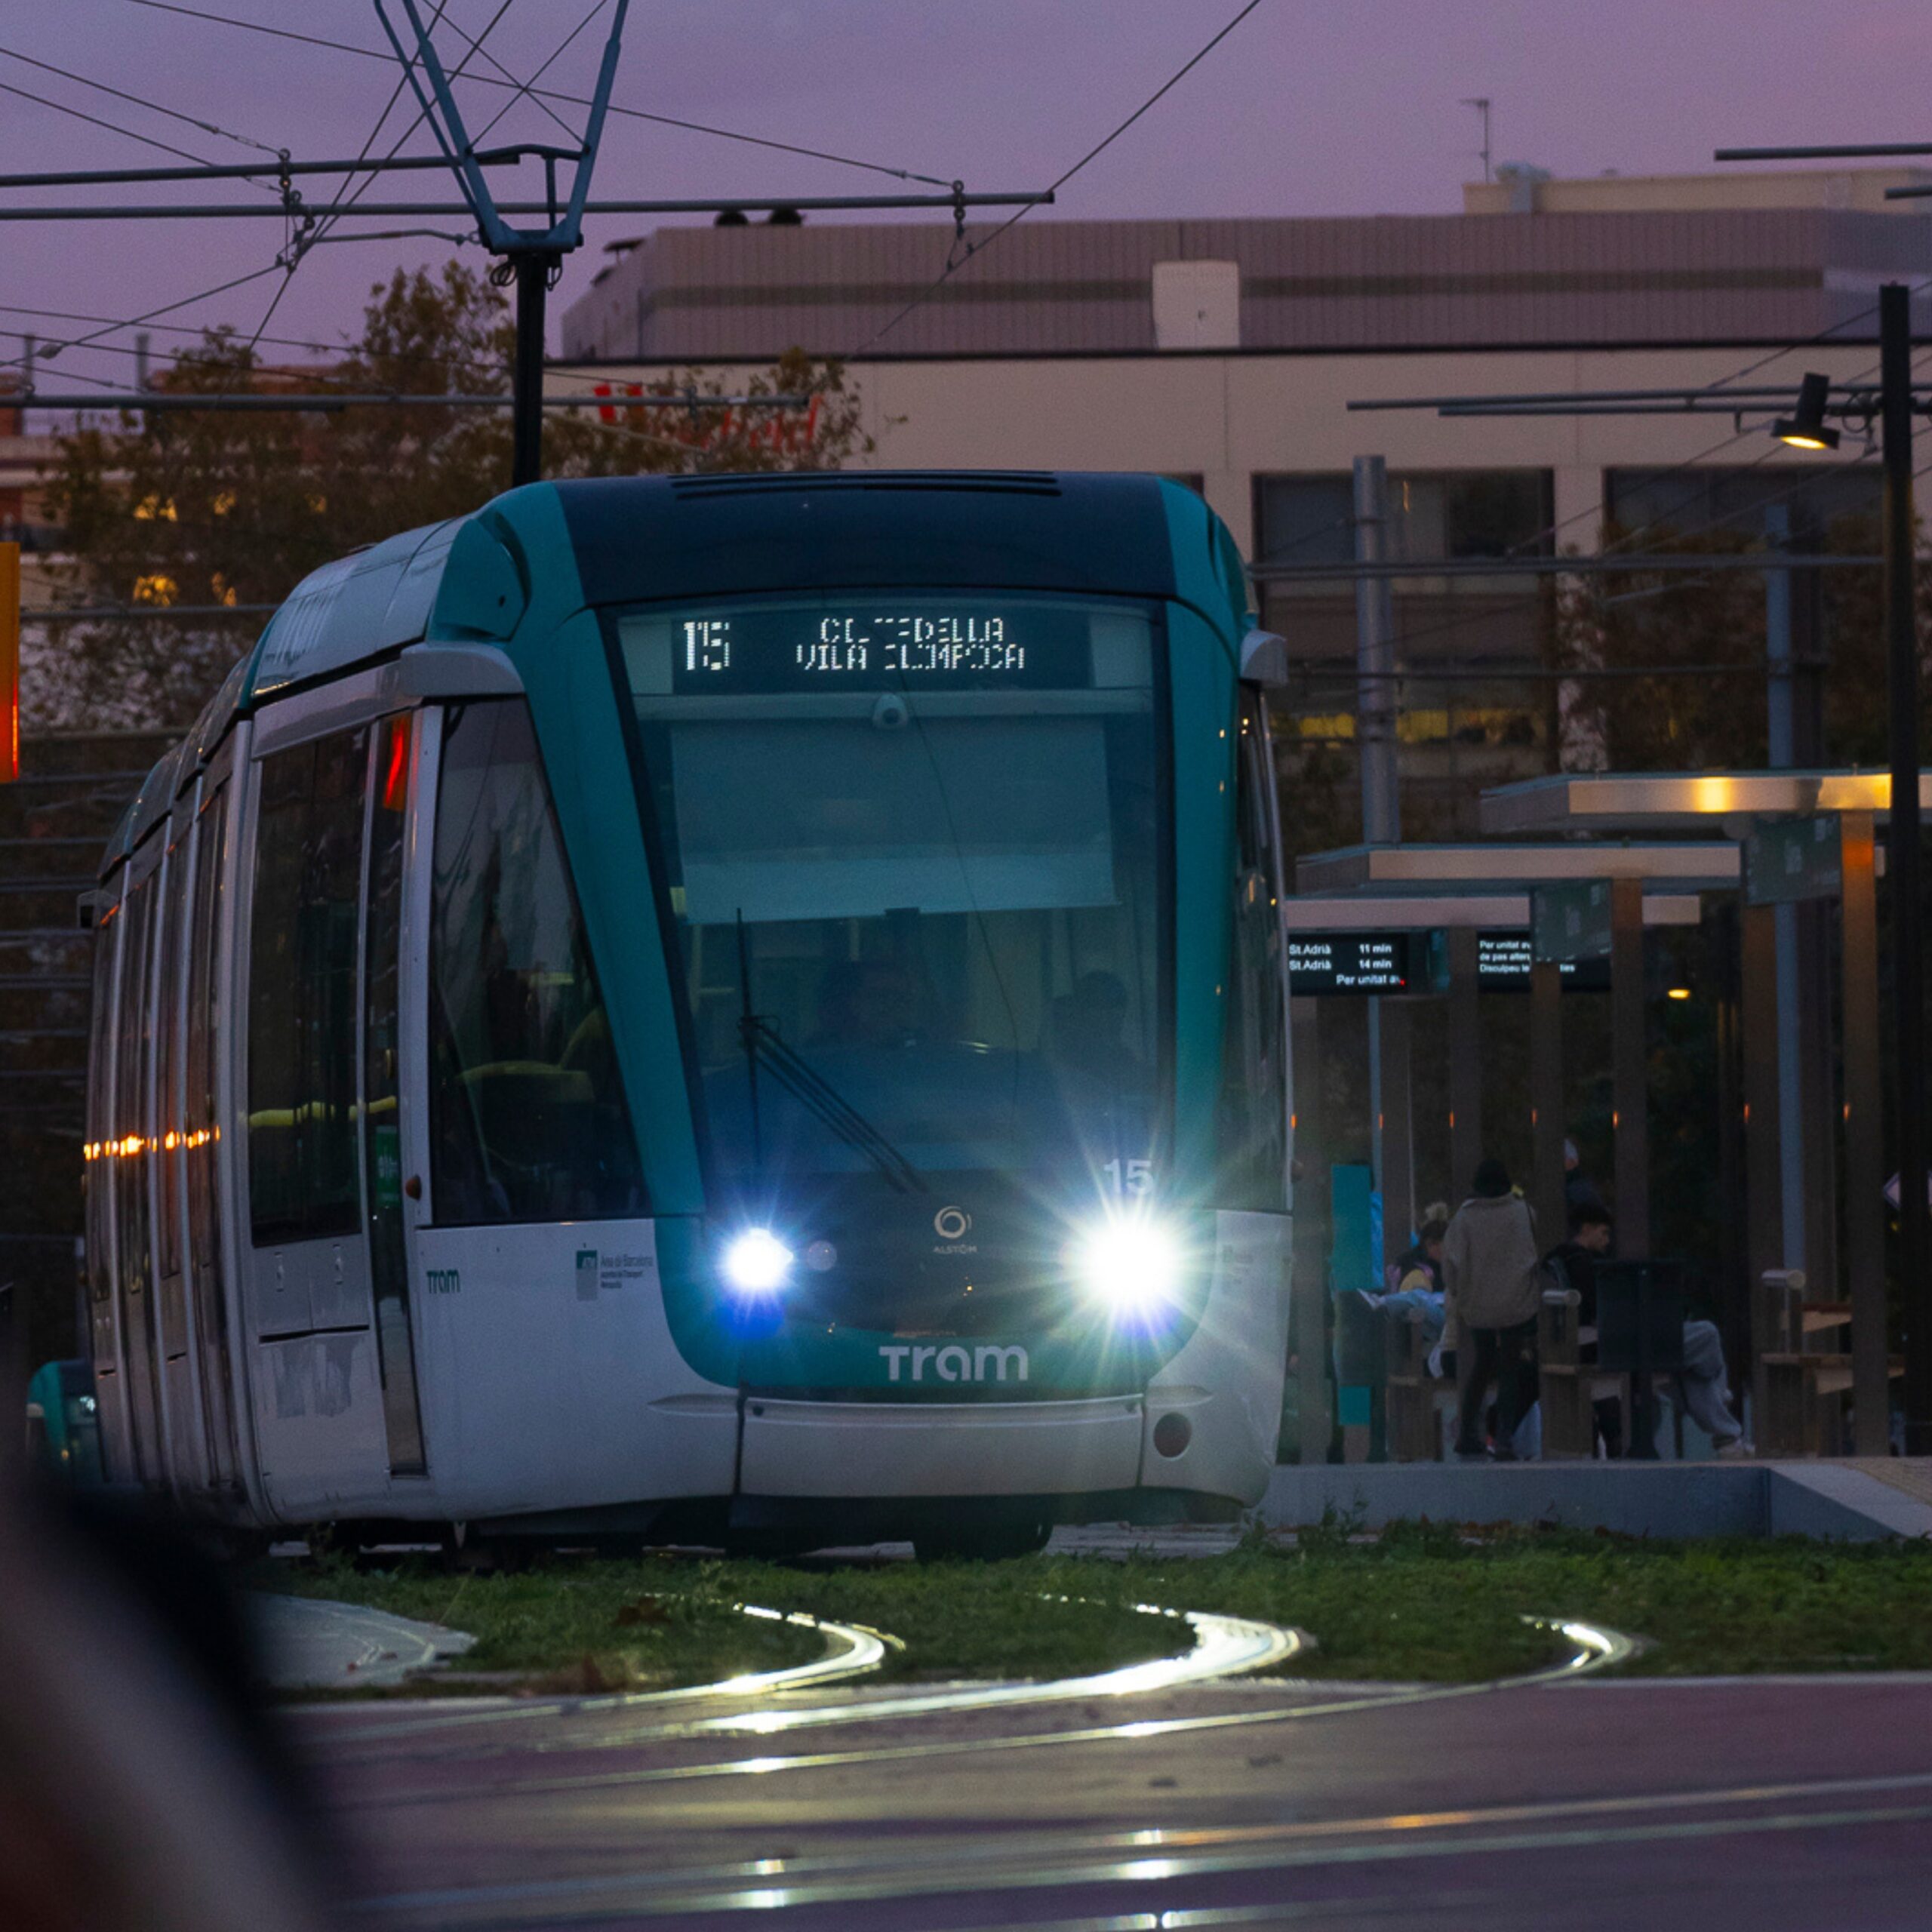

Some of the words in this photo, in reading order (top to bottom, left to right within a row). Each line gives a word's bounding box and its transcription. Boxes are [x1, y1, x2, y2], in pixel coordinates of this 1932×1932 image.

[1359, 943, 1370, 954] 11
[1372, 943, 1392, 954] min
[1479, 940, 1494, 949] Per
[1496, 940, 1520, 949] unitat
[1479, 953, 1491, 961] de
[1492, 953, 1507, 962] pas
[1359, 959, 1371, 970] 14
[1372, 959, 1392, 970] min
[1479, 964, 1521, 974] Disculpeu
[1336, 974, 1355, 986] Per
[1358, 974, 1386, 986] unitat
[1103, 1158, 1155, 1195] 15
